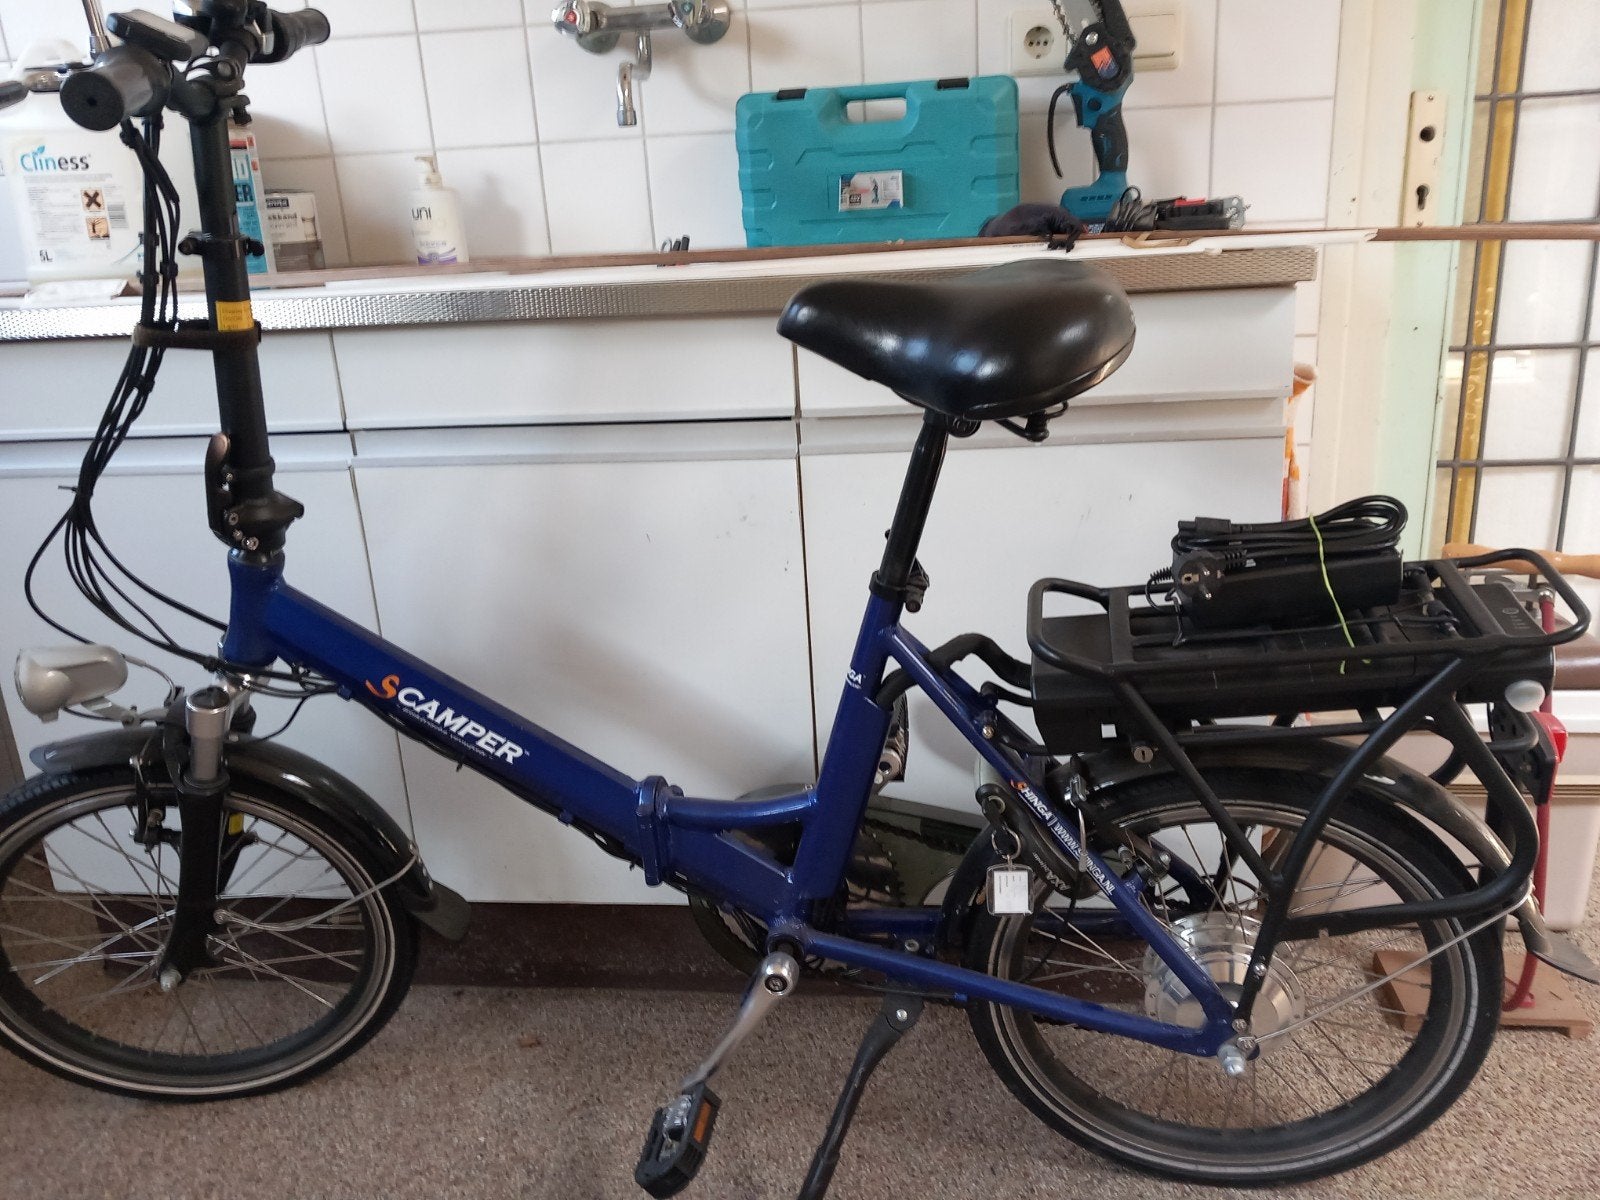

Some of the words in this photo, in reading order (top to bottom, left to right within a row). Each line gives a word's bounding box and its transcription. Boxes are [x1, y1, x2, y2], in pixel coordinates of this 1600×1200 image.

[20, 145, 89, 171] Cliness
[365, 674, 524, 765] SCAMPER
[1010, 779, 1054, 821] SHINGA
[1053, 822, 1117, 896] WWW.SINGA.NL
